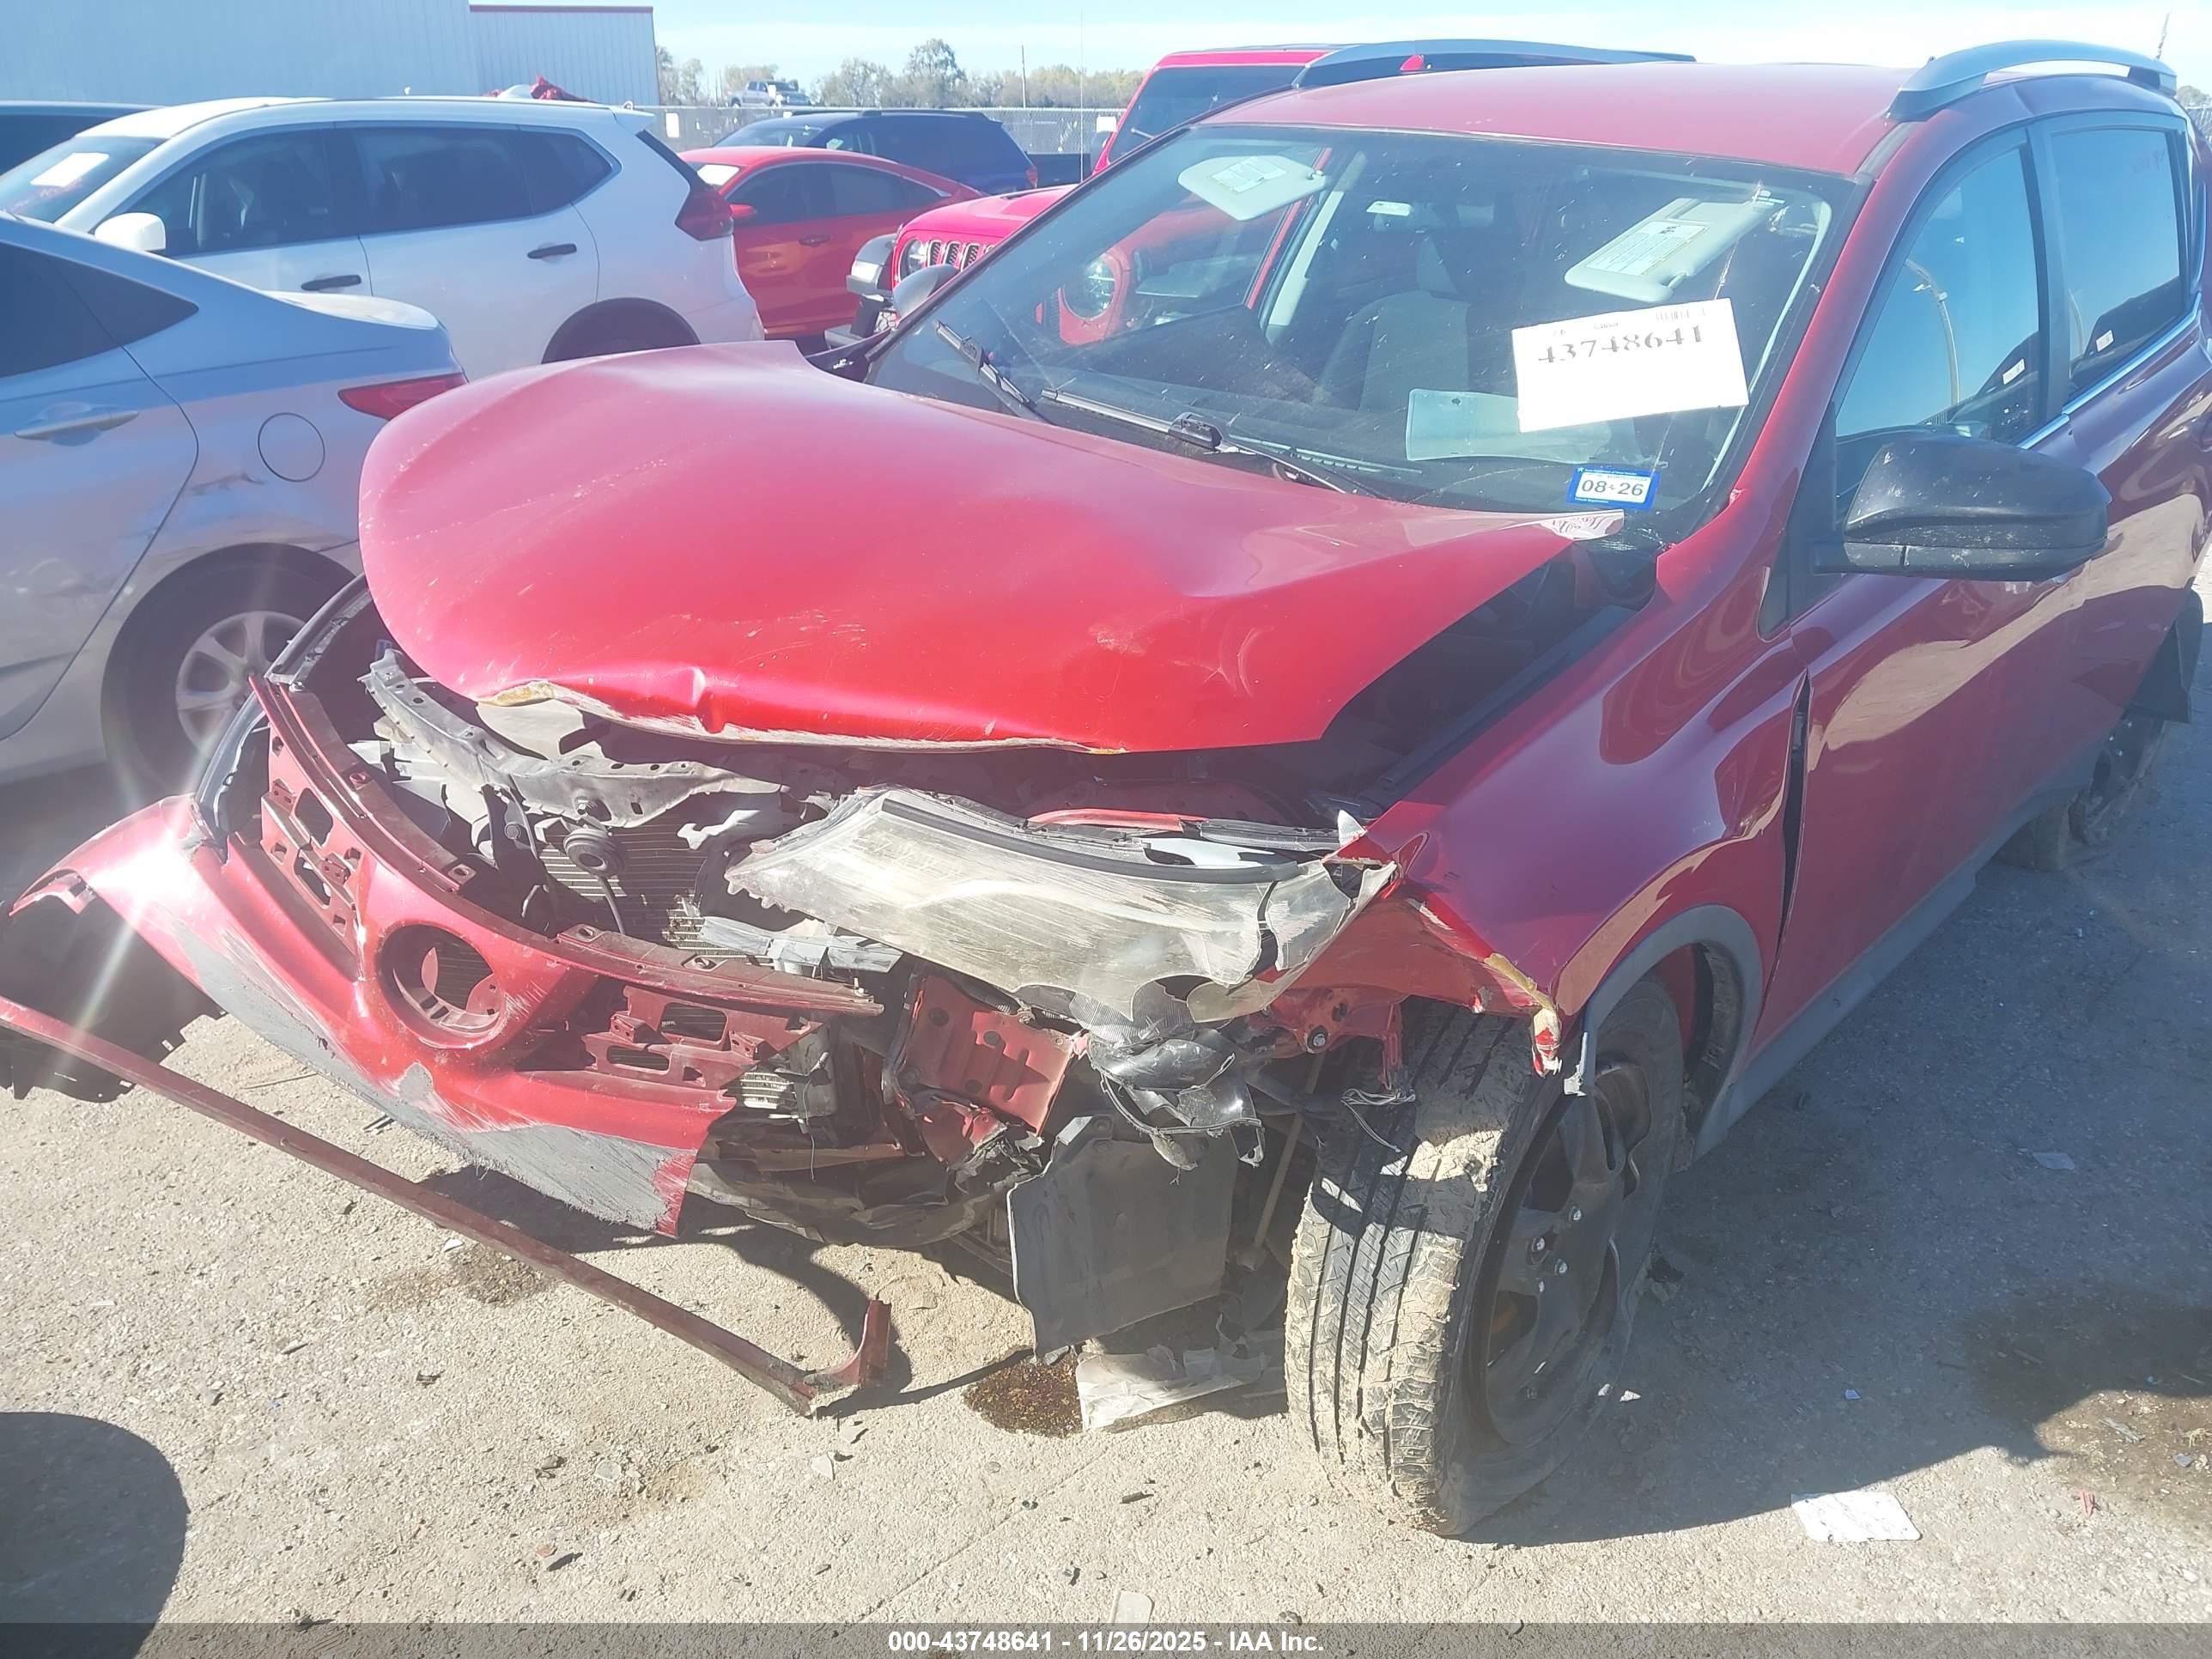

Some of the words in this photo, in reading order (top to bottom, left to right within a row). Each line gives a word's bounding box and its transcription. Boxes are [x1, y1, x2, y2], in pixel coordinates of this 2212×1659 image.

[1538, 324, 1703, 363] 43748641
[1581, 479, 1607, 494] 08
[1617, 482, 1644, 497] 26
